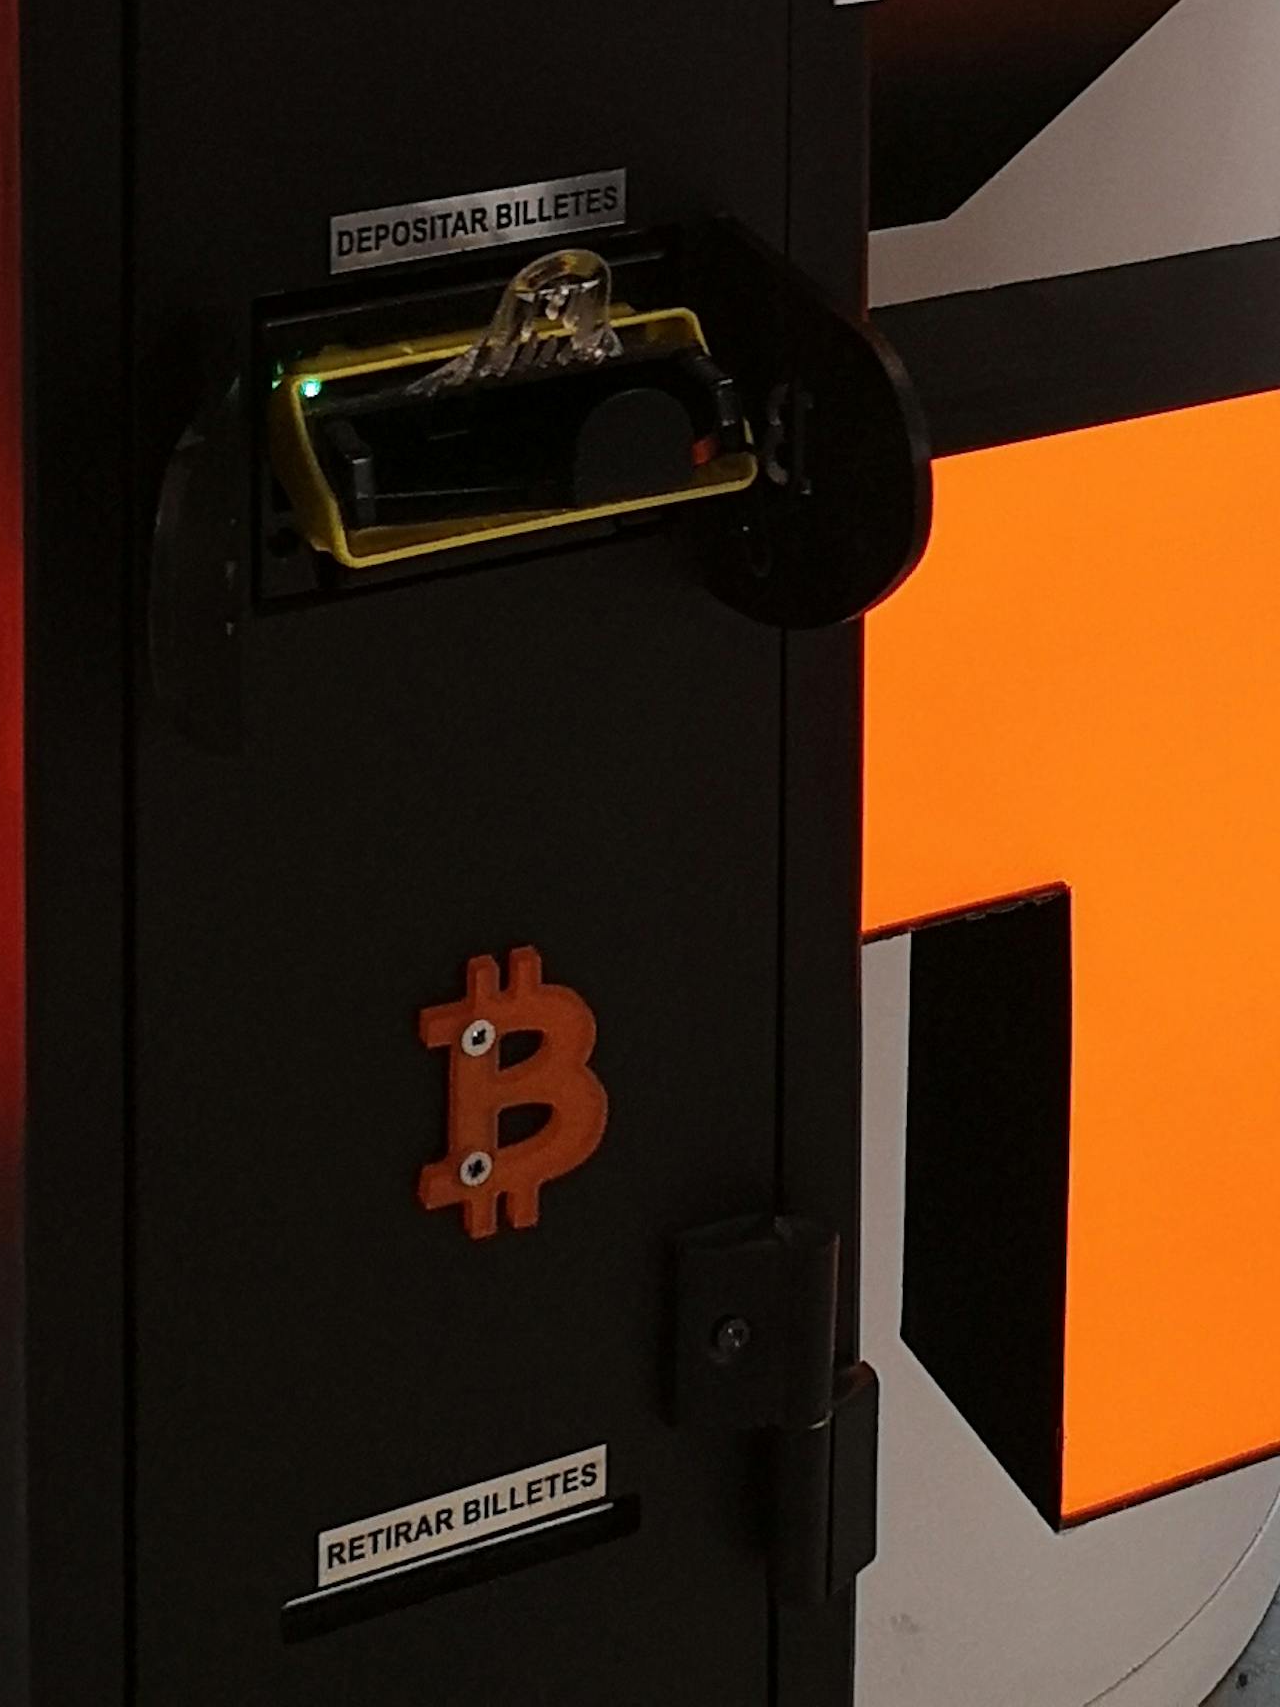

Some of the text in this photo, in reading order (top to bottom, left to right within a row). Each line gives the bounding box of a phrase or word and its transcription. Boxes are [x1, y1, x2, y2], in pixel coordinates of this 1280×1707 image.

[336, 185, 618, 257] DEPOSITAR BILLETES
[326, 1461, 599, 1569] RETIRAR BILLETES
